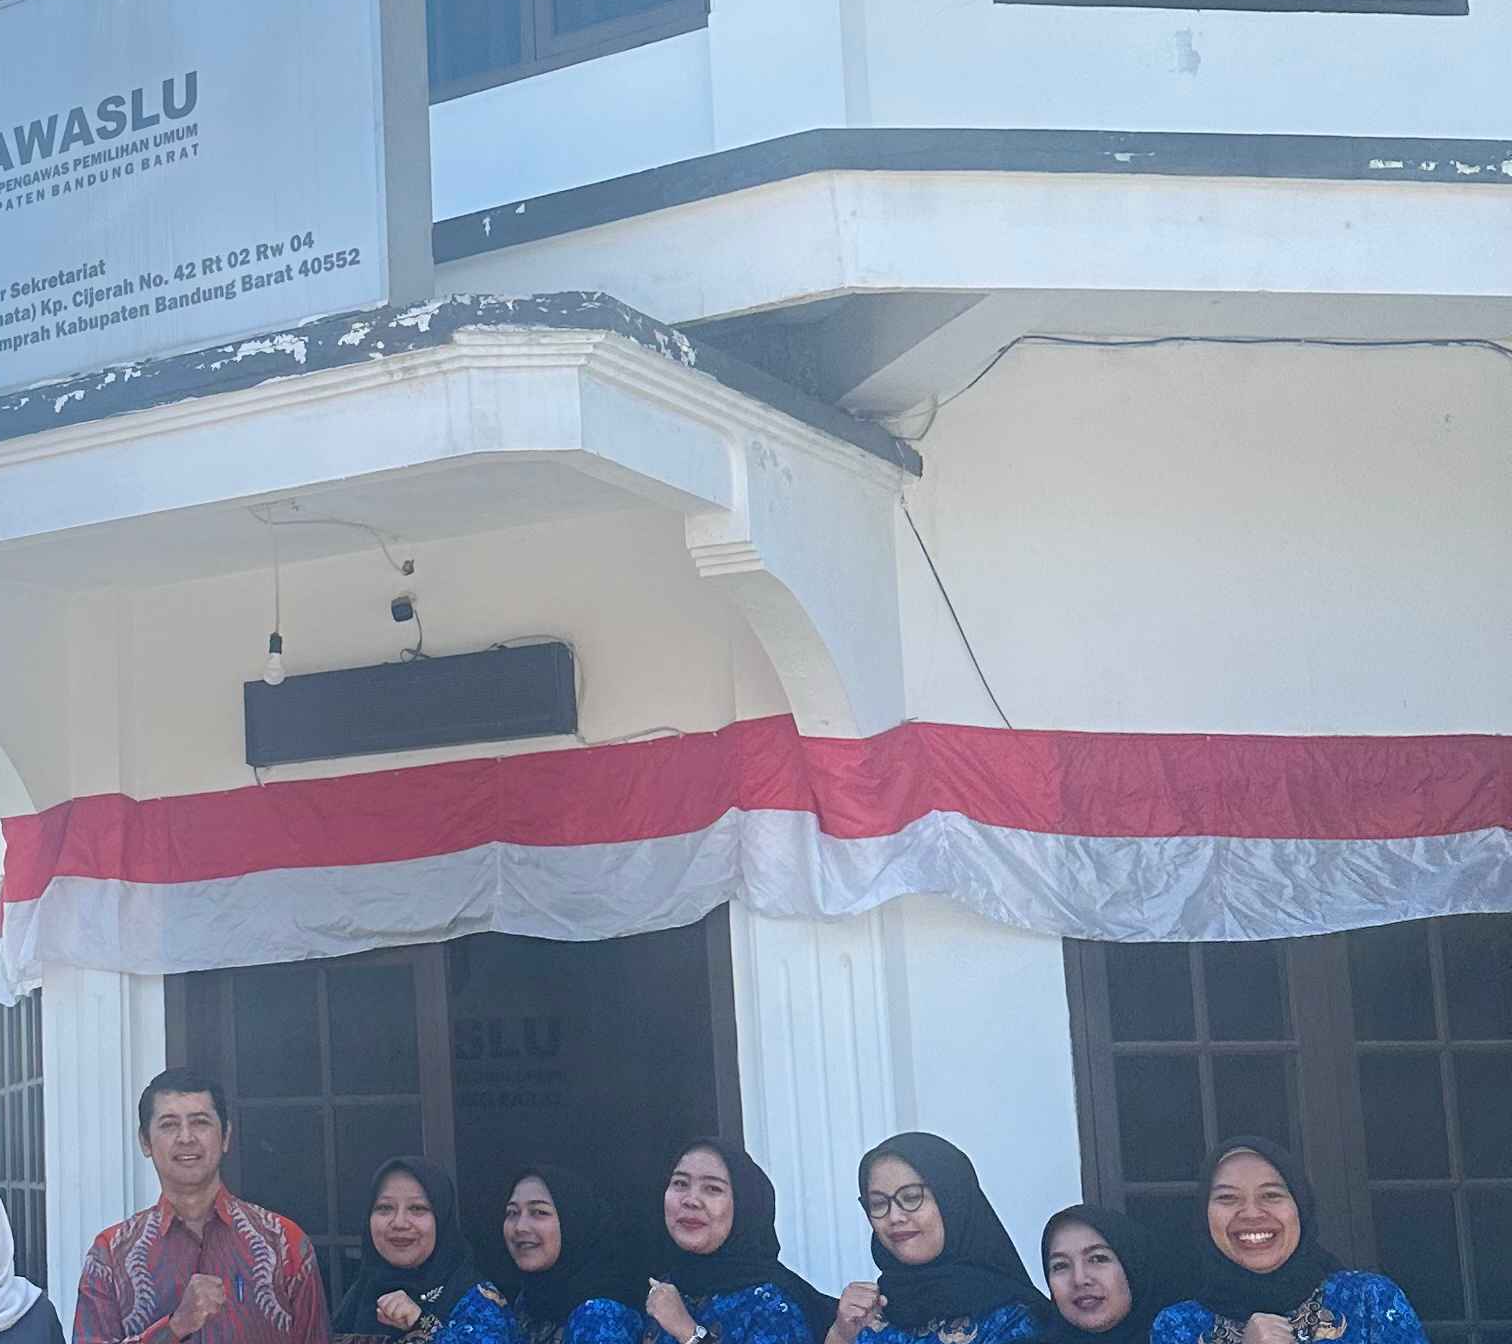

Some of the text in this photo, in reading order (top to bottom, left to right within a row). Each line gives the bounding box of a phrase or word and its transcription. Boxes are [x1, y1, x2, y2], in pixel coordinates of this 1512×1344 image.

[51, 162, 135, 197] BANDUNG
[141, 143, 200, 171] BARAT
[73, 138, 149, 172] PEMILIHAN
[153, 123, 199, 148] UMUM
[10, 259, 106, 299] Sekretariat
[40, 297, 67, 317] Kp.
[72, 277, 134, 308] Cijerah
[139, 270, 169, 291] No.
[173, 261, 197, 282] 42
[201, 254, 223, 276] Rt
[227, 247, 251, 269] 02
[255, 240, 284, 261] Rw
[290, 231, 315, 253] 04
[55, 303, 150, 339] Kabupaten
[155, 278, 237, 314] Bandung
[241, 264, 294, 293] Barat
[298, 247, 361, 278] 40552
